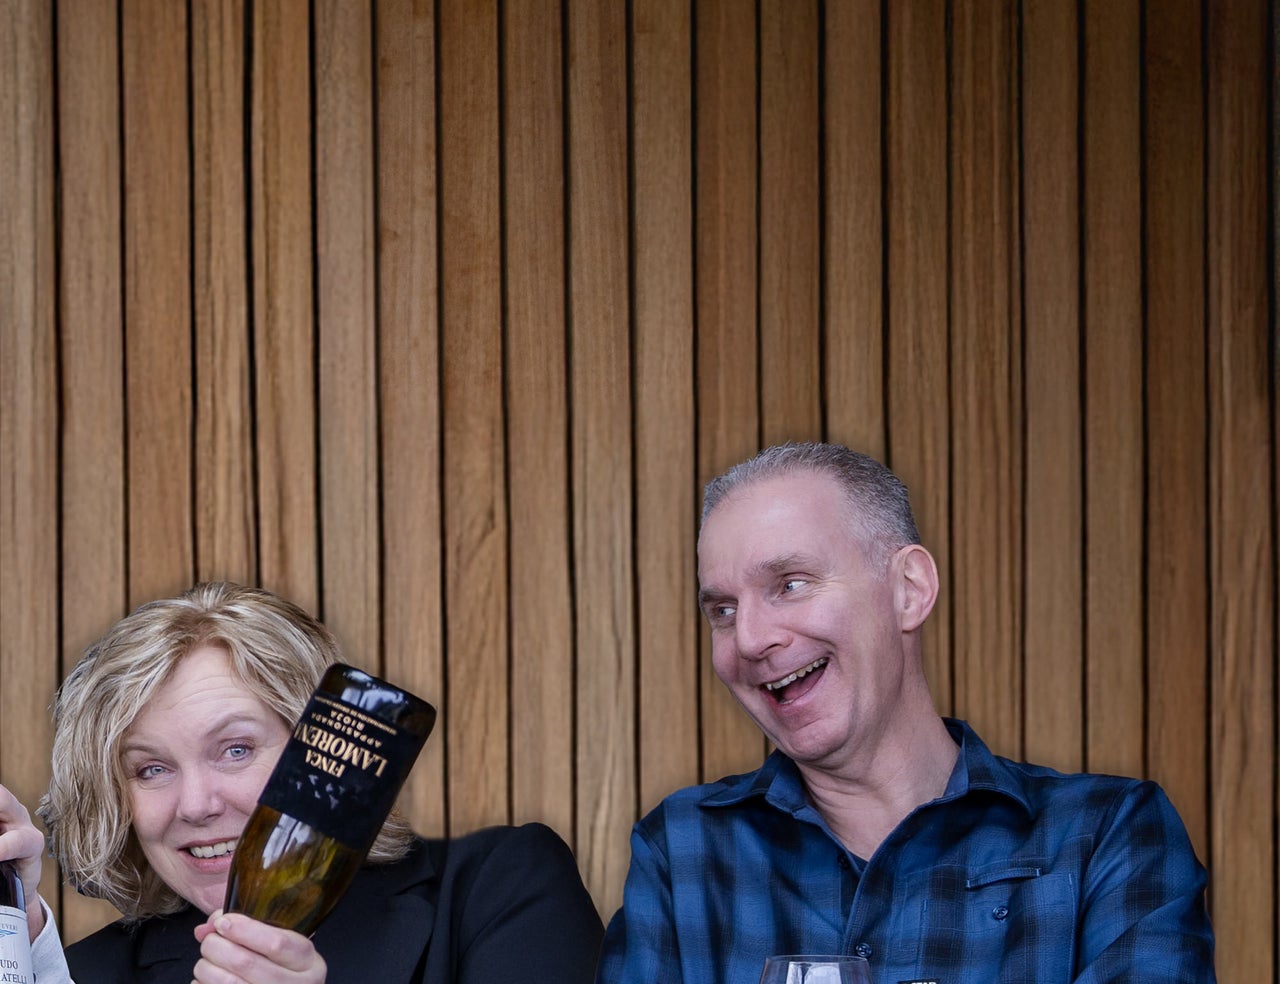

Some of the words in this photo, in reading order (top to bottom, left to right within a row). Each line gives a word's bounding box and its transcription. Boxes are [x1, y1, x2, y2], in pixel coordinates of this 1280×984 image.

[311, 712, 382, 748] APPASIONADA
[330, 711, 365, 731] RIOJA
[294, 722, 388, 777] LAMOREN
[305, 749, 346, 778] FINCA
